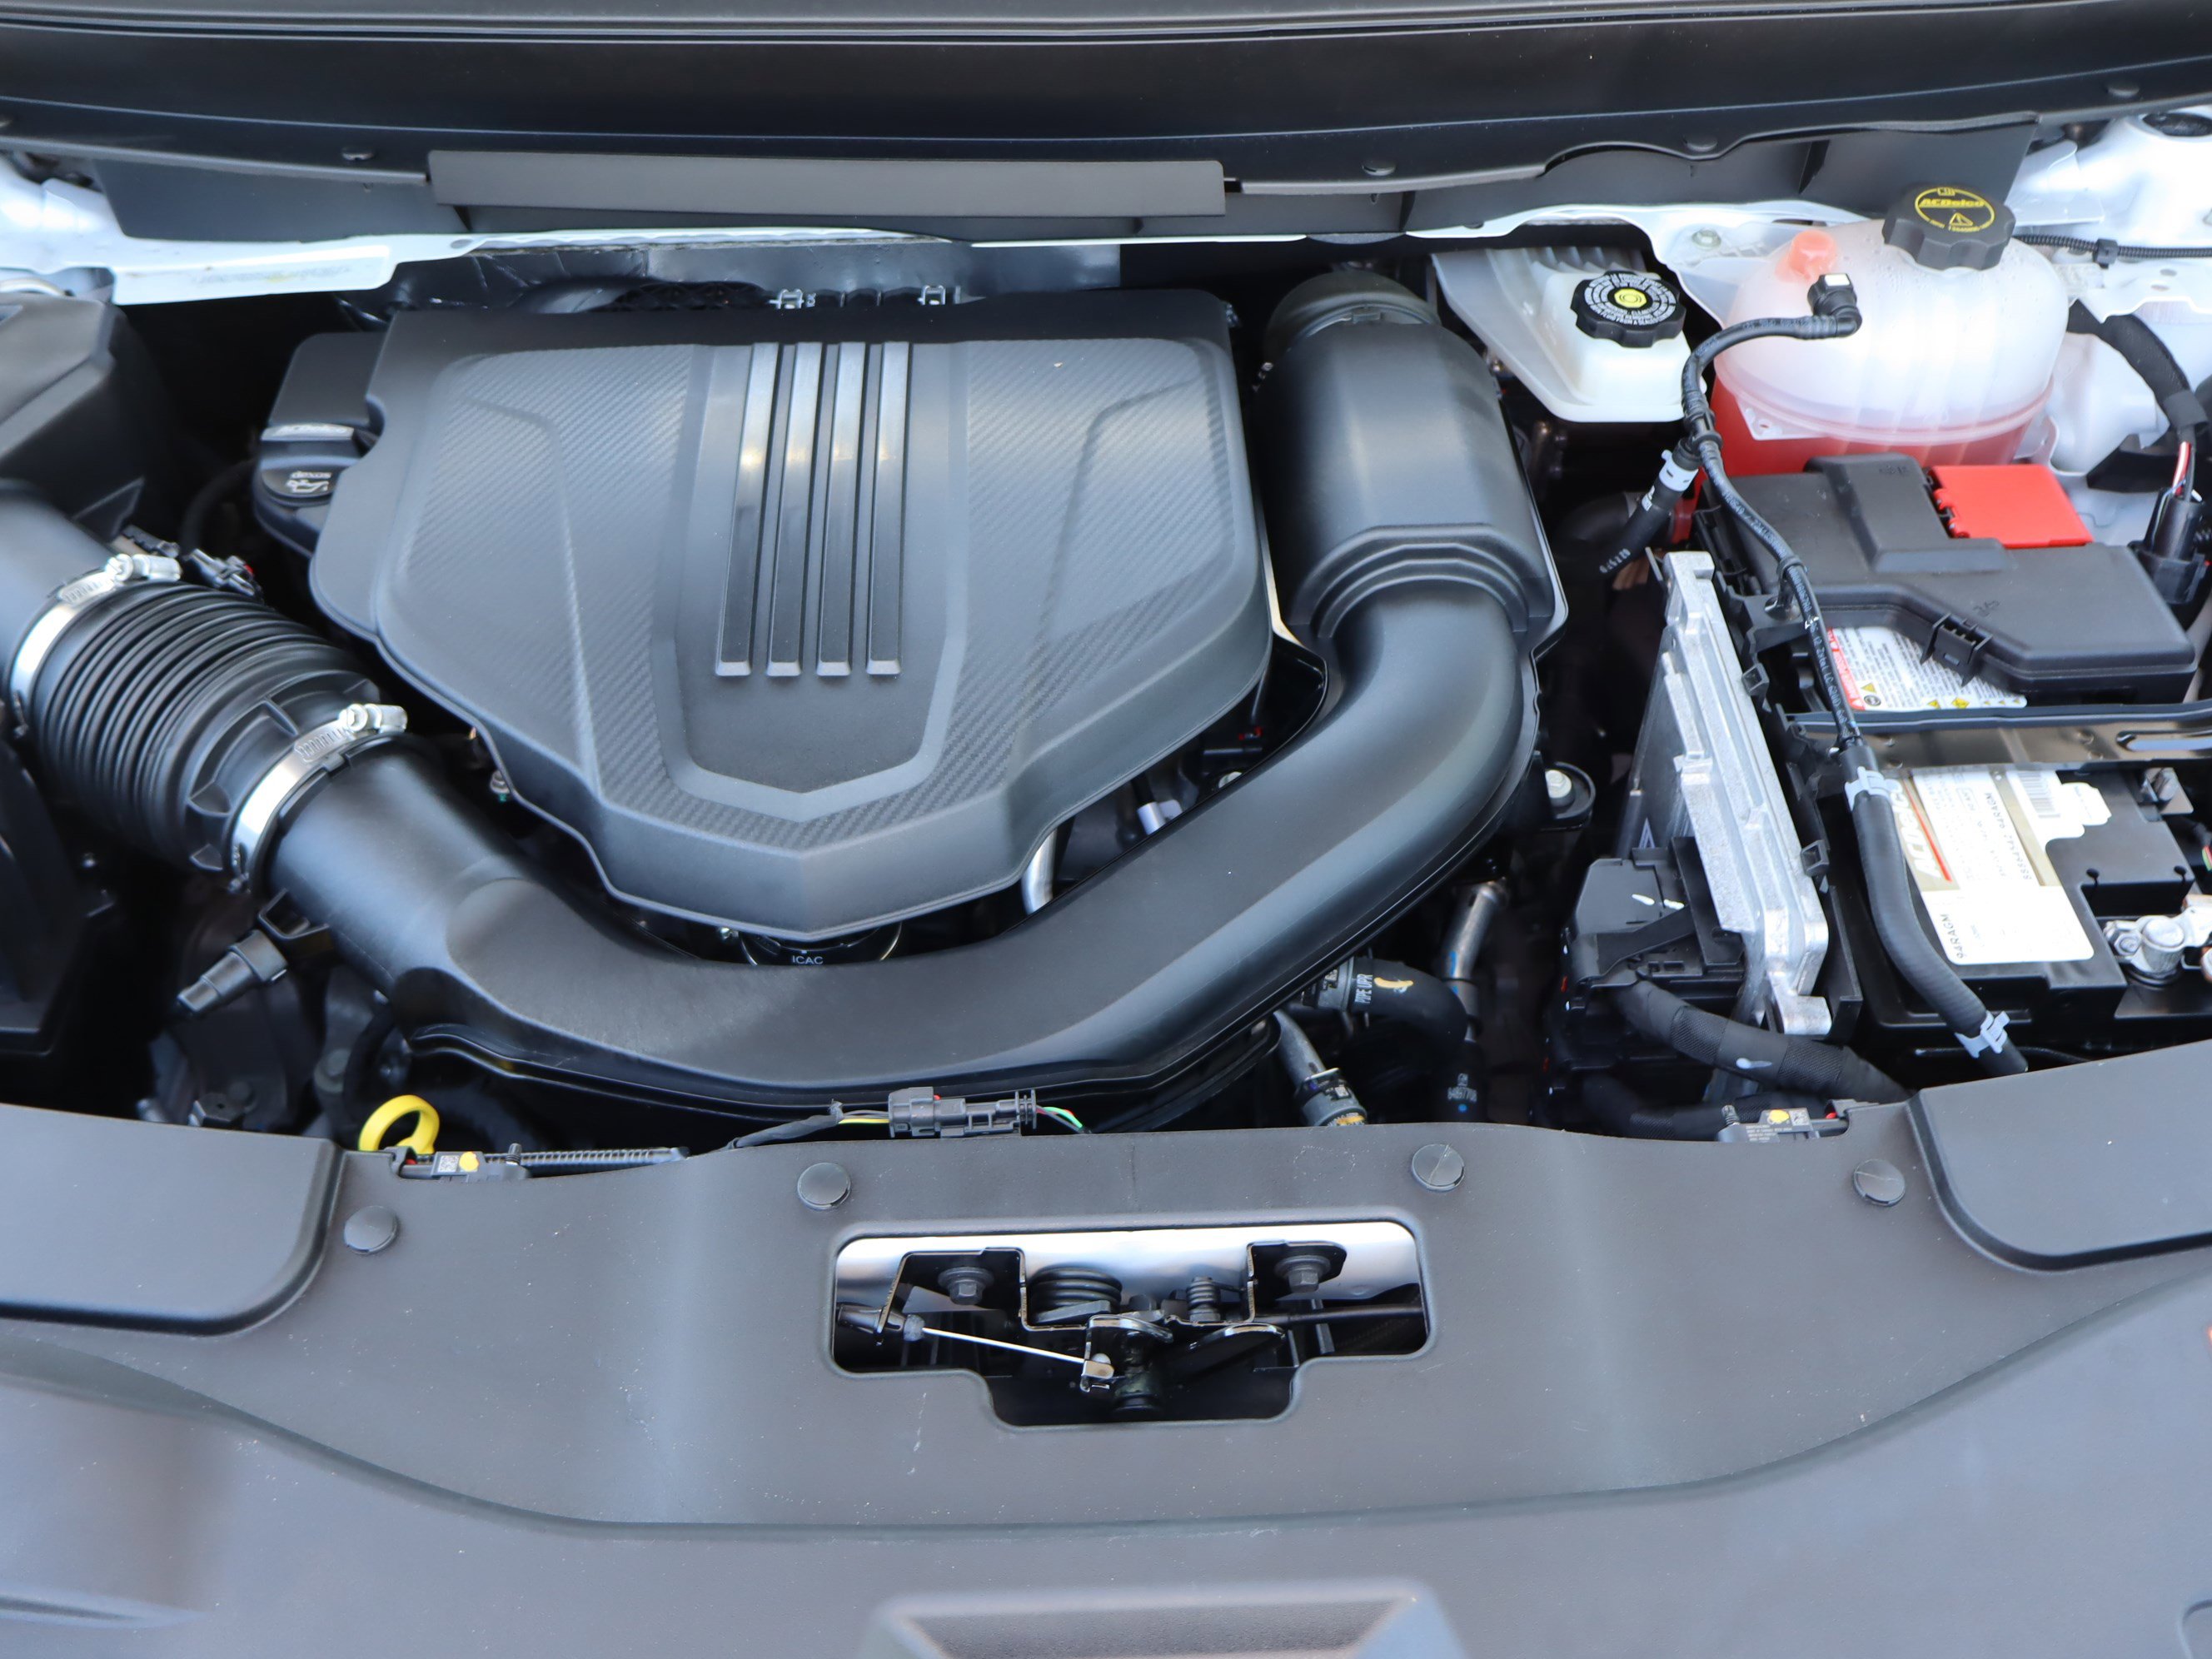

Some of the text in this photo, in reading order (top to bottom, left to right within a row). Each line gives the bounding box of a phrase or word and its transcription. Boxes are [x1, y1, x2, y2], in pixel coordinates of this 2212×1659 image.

[1887, 787, 1942, 879] ACDelc
[1940, 914, 1964, 959] 94RAGM
[1355, 974, 1373, 1004] PIPE UPR
